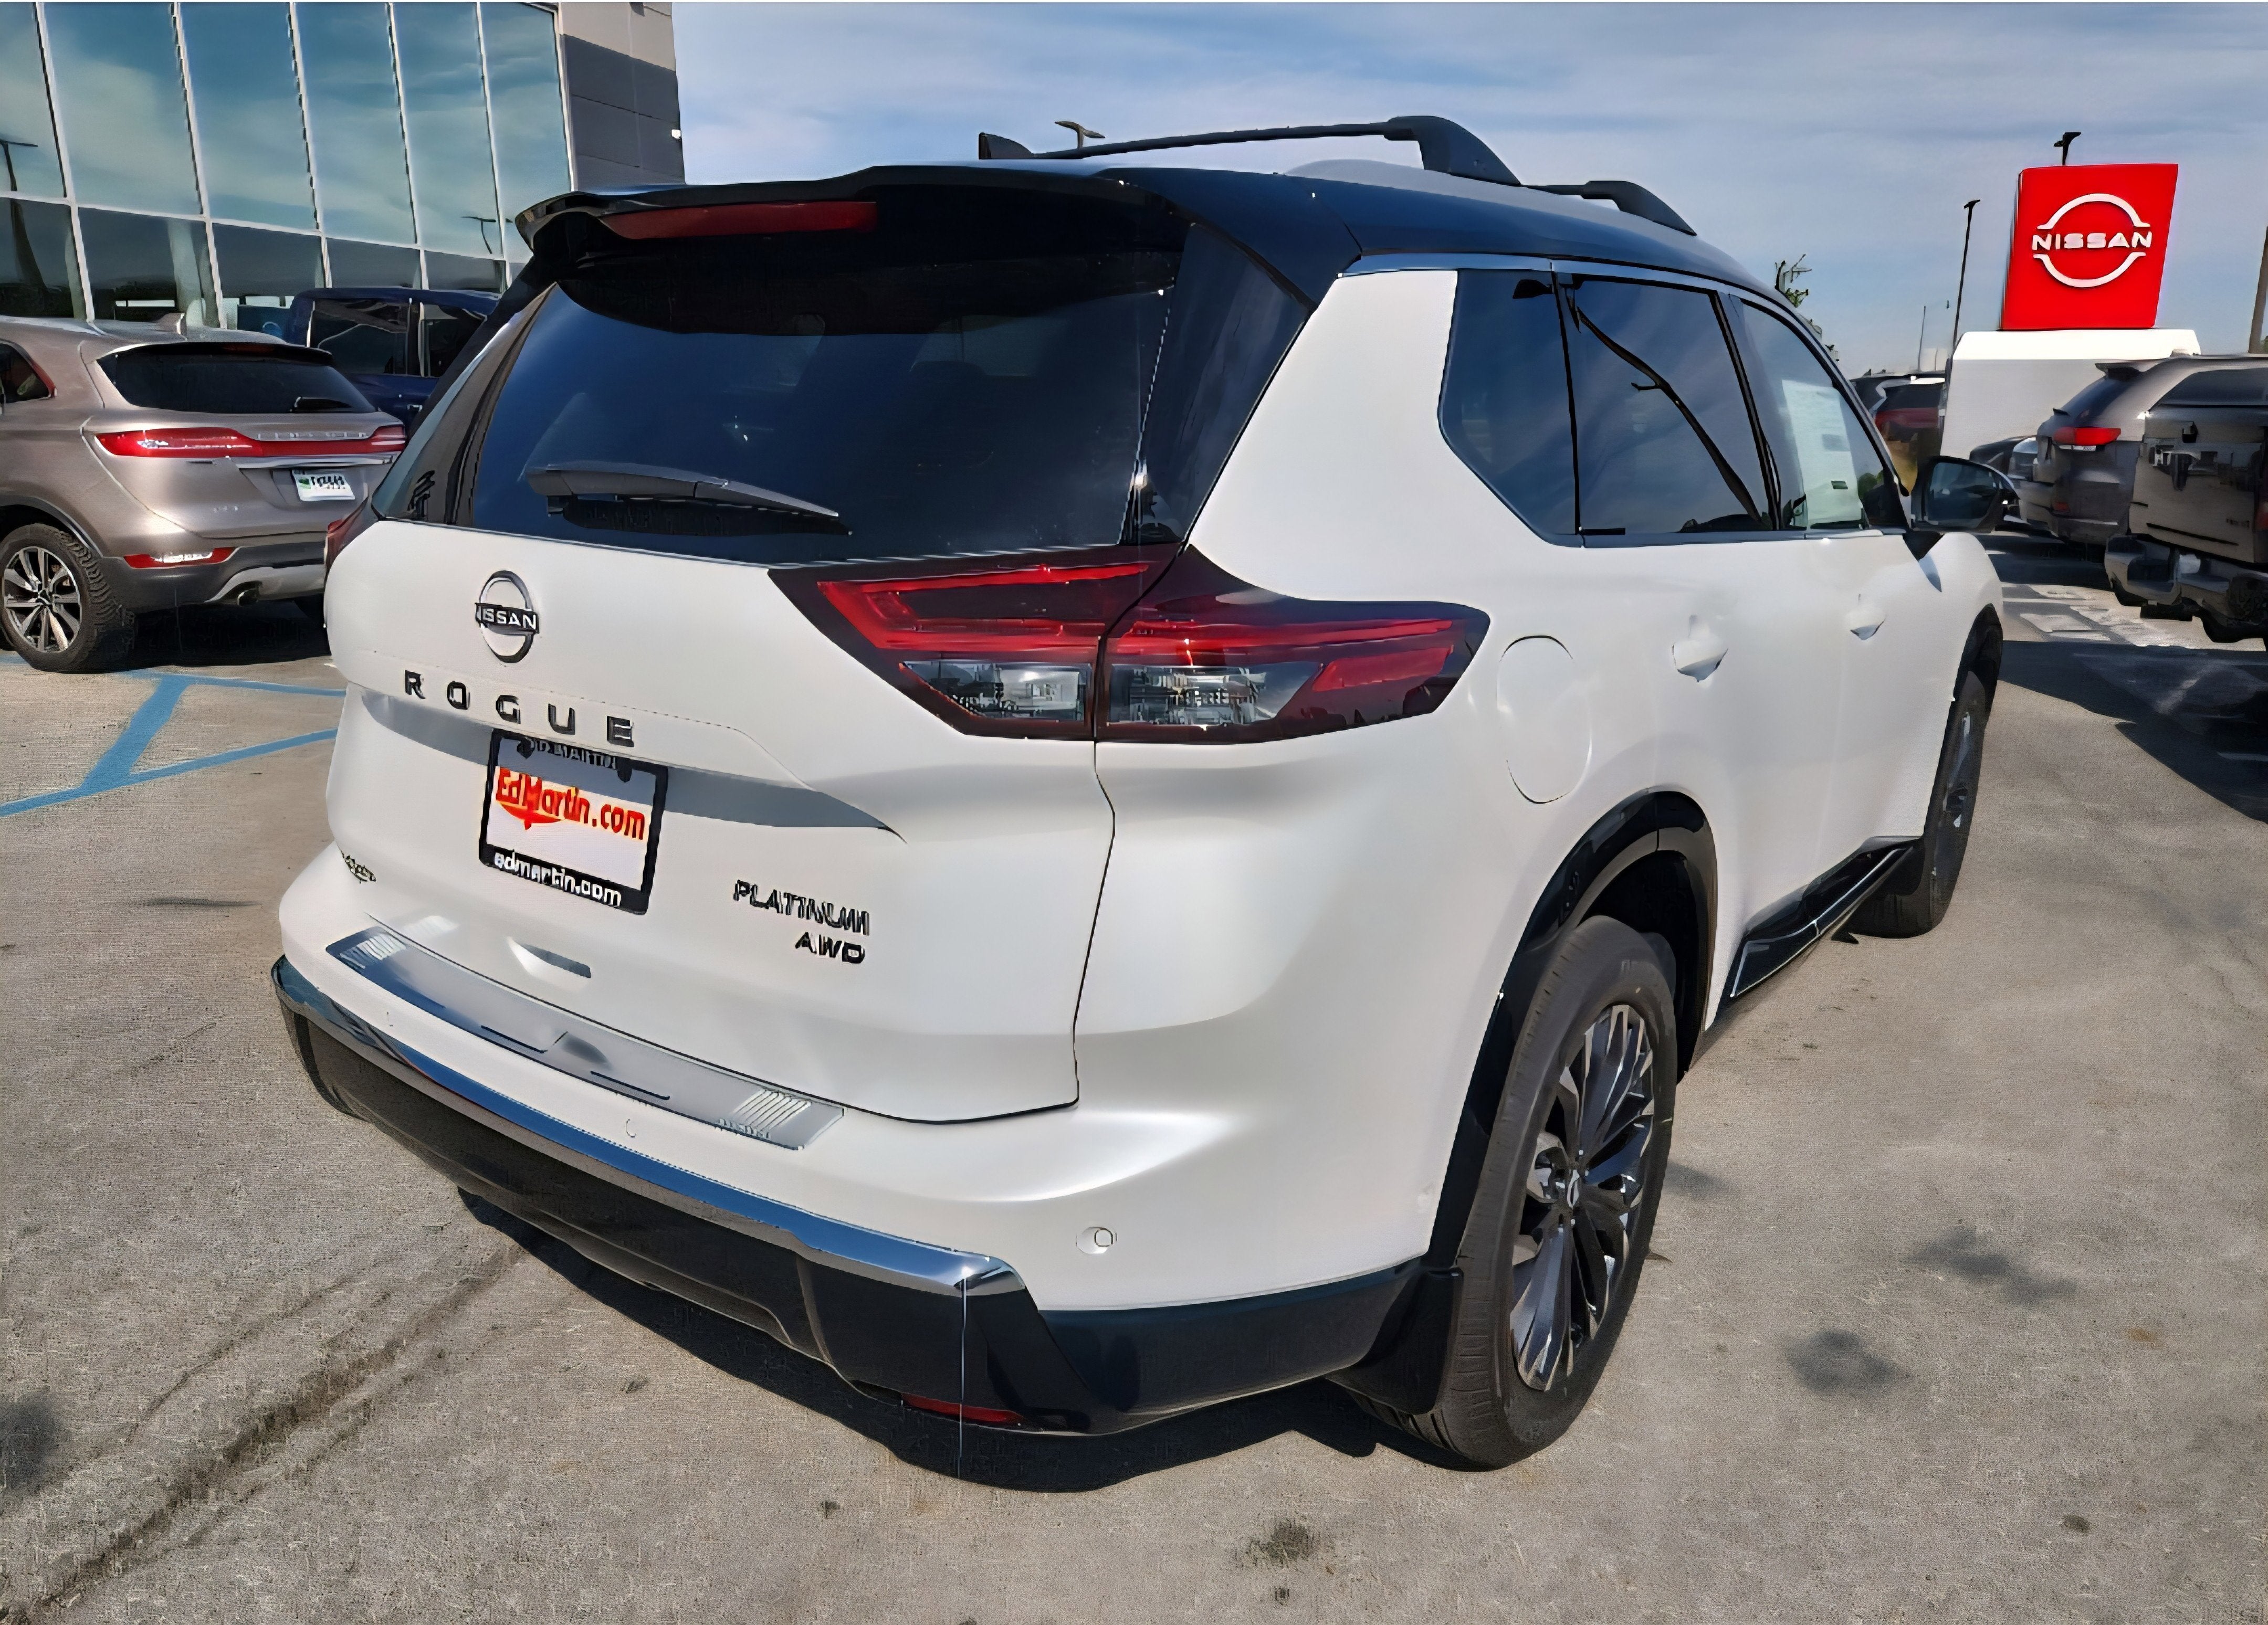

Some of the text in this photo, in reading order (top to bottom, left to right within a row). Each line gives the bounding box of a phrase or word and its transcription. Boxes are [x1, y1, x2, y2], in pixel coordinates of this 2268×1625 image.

[2032, 231, 2152, 251] NISSAN
[404, 669, 635, 747] ROGUE
[733, 879, 870, 936] PLATINUM
[795, 932, 865, 964] AWD
